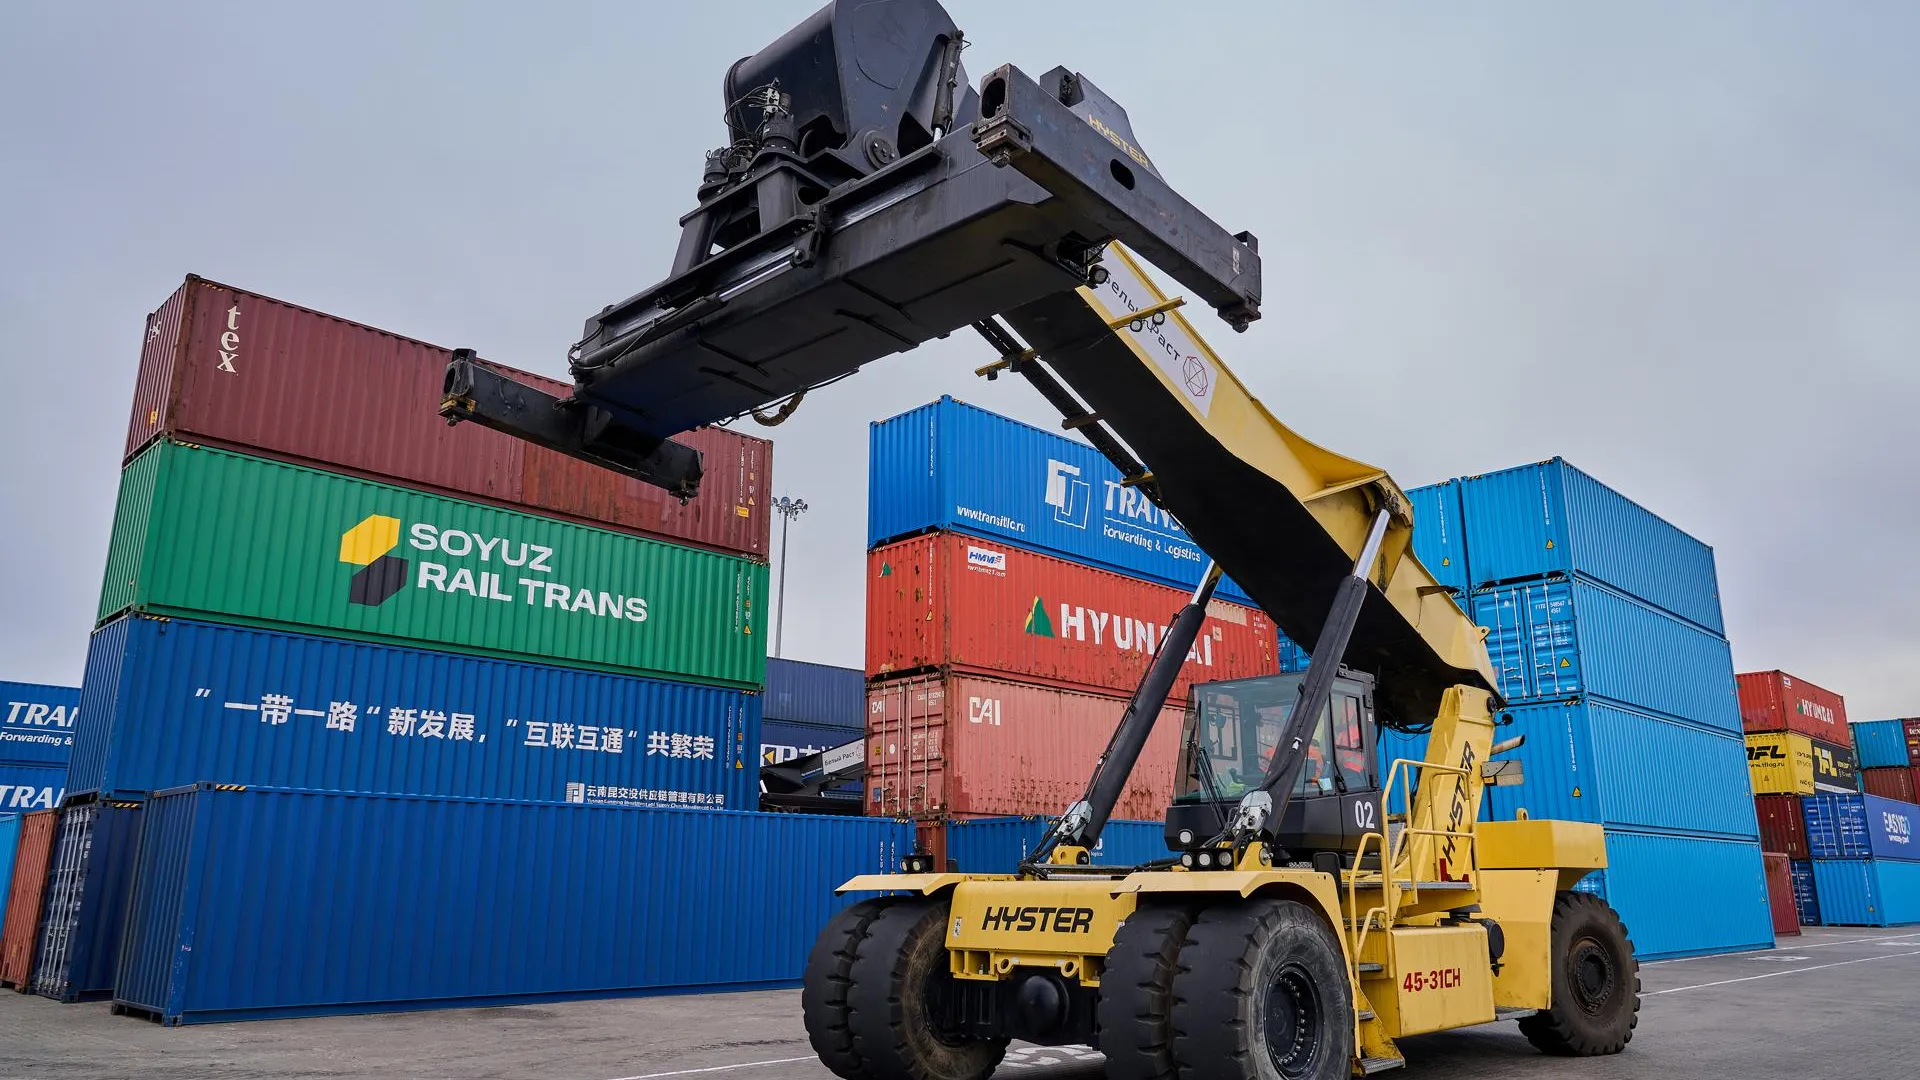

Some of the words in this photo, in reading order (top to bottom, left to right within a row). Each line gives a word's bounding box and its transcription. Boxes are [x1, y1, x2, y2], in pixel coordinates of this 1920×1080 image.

[1088, 114, 1150, 169] HYSTER
[409, 523, 553, 573] SOYUZ
[1103, 523, 1153, 552] Forwarding
[1155, 539, 1161, 552] &
[1164, 541, 1201, 562] Logistics
[417, 561, 513, 602] RAIL
[518, 578, 648, 622] TRANS
[969, 696, 1001, 726] CAI
[0, 731, 62, 746] Forwarding
[64, 736, 73, 746] &
[1354, 800, 1375, 829] 02
[981, 906, 1094, 934] HYSTER
[1402, 967, 1461, 993] 45-31CH
